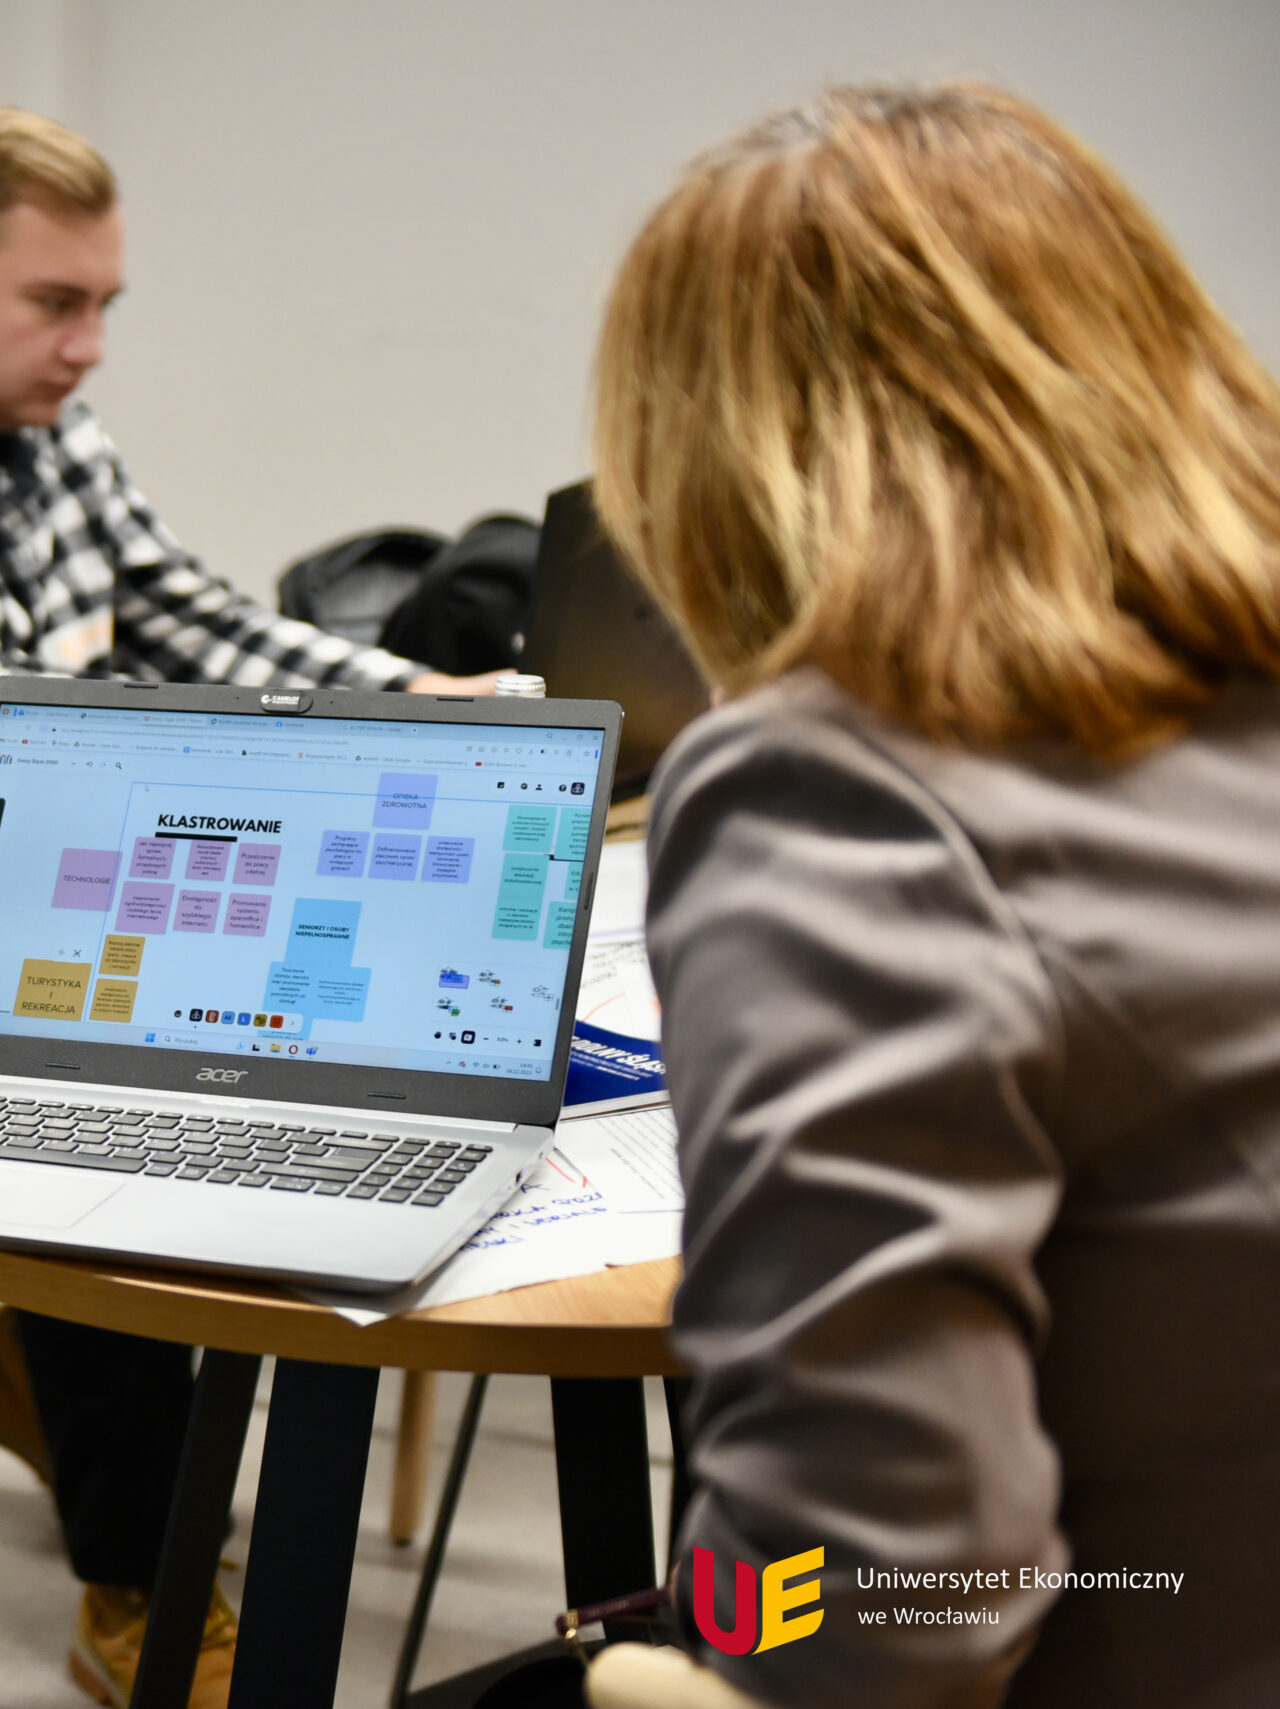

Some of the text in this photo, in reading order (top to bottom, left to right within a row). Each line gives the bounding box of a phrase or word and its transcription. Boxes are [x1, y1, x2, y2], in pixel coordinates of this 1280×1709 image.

[381, 801, 427, 809] ZDROWOTNA
[157, 814, 282, 833] KLASTROWANIE
[63, 875, 111, 885] TECHNOLOGIE
[27, 976, 81, 989] TURYSTYKA
[21, 1001, 75, 1014] REKREACJA
[195, 1067, 248, 1084] acer
